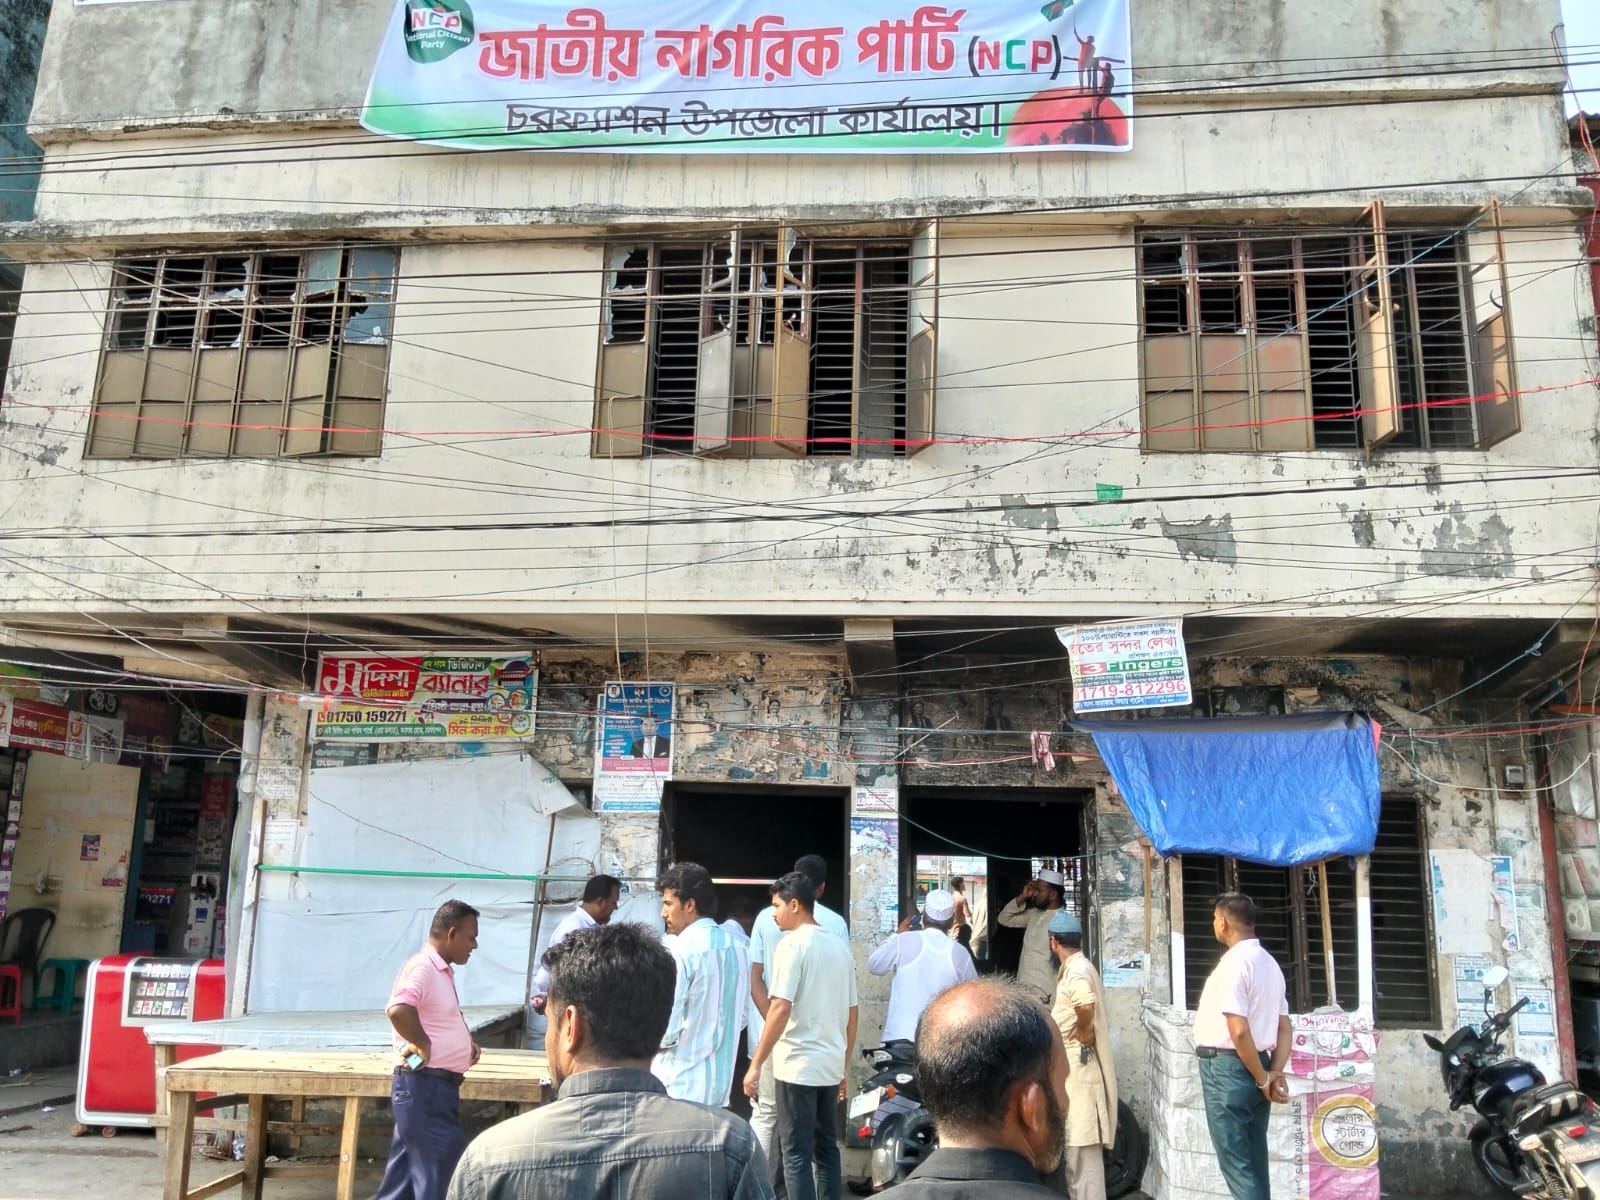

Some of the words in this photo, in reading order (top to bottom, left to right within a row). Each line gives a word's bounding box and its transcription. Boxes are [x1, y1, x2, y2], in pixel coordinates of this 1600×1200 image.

[412, 11, 460, 28] NCP
[421, 41, 446, 49] Party
[437, 30, 471, 43] Citizen
[478, 8, 643, 82] জাতীয়
[655, 14, 844, 82] নাগরিক
[857, 6, 968, 74] পার্টি
[968, 34, 1062, 81] (NCP)
[506, 103, 670, 136] চরফ্যাশন
[681, 101, 829, 137] উপজেলা
[1108, 638, 1142, 655] সুন্দর
[1147, 635, 1177, 650] লেখা
[1081, 663, 1105, 675] 3
[1106, 656, 1183, 672] Fingers
[421, 674, 491, 697] ব্যানার
[1074, 680, 1187, 700] 01719-812296
[326, 711, 362, 723] 01750
[366, 711, 407, 723] 159271
[448, 721, 467, 736] সিল
[471, 724, 490, 737] করা
